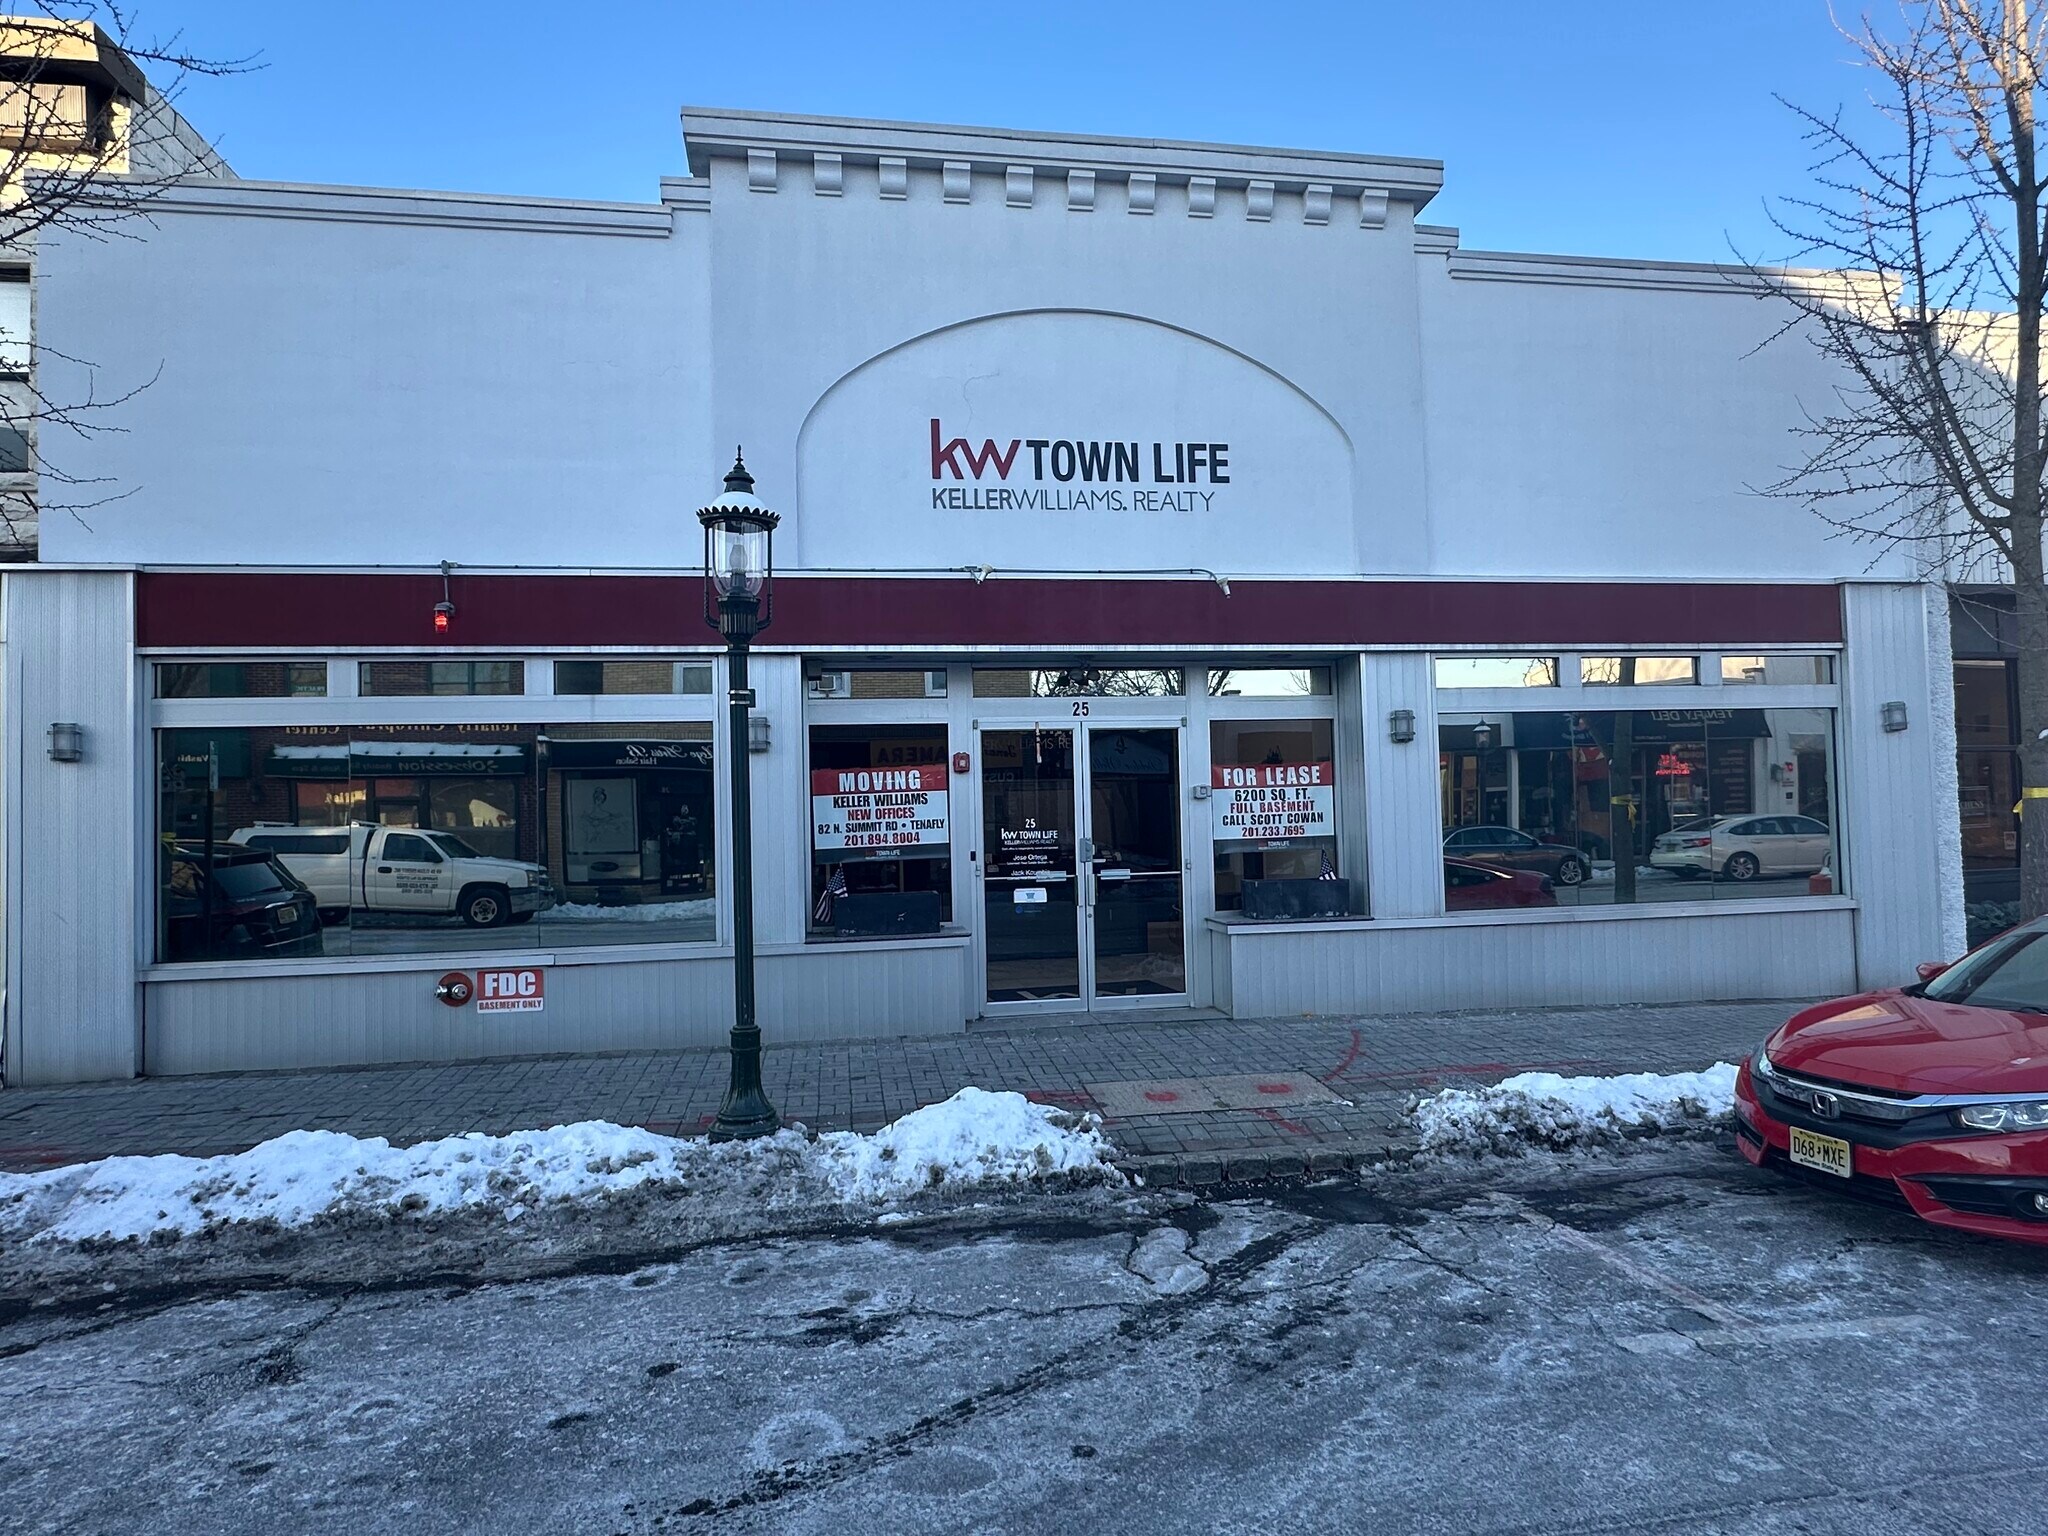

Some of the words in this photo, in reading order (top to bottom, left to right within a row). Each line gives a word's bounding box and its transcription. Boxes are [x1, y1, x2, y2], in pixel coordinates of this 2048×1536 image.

[930, 418, 1021, 480] kw
[1026, 439, 1140, 483] TOWN
[1153, 442, 1231, 484] LIFE
[1134, 490, 1215, 512] REALTY
[1072, 701, 1089, 716] 25
[838, 769, 921, 792] MOVING
[1222, 768, 1257, 786] FOR
[1265, 765, 1321, 785] LEASE
[833, 795, 870, 808] KELLER
[873, 792, 928, 806] WILLIAMS
[1234, 789, 1266, 802] 6200
[1270, 788, 1290, 802] SQ.
[1295, 787, 1311, 800] FT.
[847, 808, 871, 821] NEW
[875, 806, 915, 819] OFFICES
[1230, 802, 1255, 814] FULL
[1259, 800, 1315, 813] BASEMENT
[817, 823, 831, 834] 82
[833, 823, 842, 834] N.
[845, 821, 882, 833] SUMMIT
[885, 821, 898, 831] RD
[910, 818, 945, 829] TENAFLY
[1025, 818, 1036, 828] 25
[1222, 814, 1246, 826] CALL
[1250, 813, 1283, 825] SCOTT
[1287, 812, 1324, 824] COWAN
[844, 831, 921, 846] 201.894.8004
[1001, 827, 1018, 840] kw
[1018, 830, 1041, 840] TOWN
[1042, 829, 1059, 839] LIFE
[1241, 825, 1305, 838] 201.233.7695
[484, 971, 536, 997] FDC
[479, 1001, 521, 1011] BASEMENT
[522, 1000, 542, 1009] ONLY
